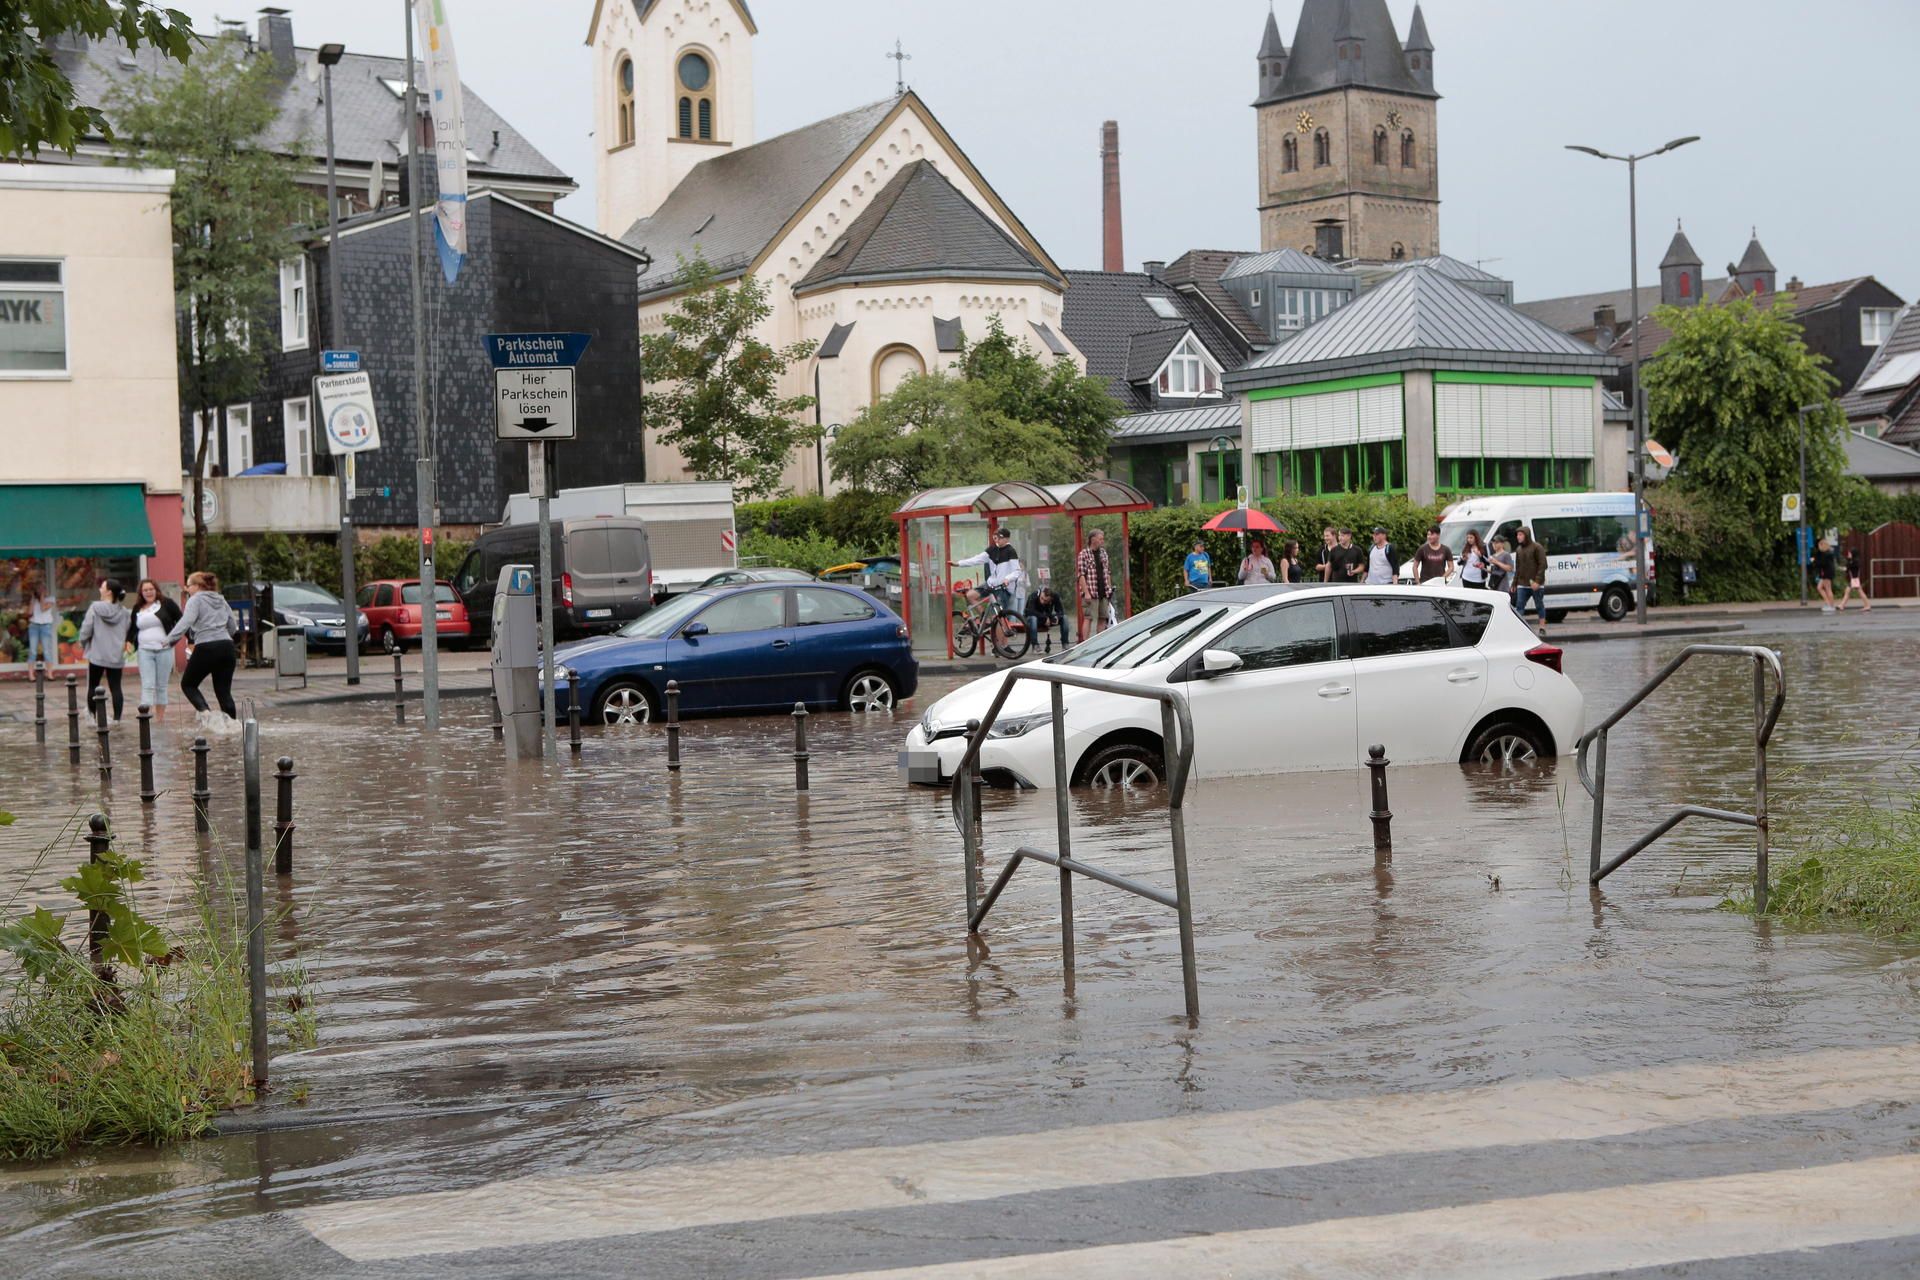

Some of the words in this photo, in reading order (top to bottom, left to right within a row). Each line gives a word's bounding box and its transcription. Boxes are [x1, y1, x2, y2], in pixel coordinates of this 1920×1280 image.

[497, 337, 564, 351] Parkschein
[508, 351, 559, 364] Automat
[522, 373, 547, 385] Hier
[501, 387, 568, 400] Parkschein
[519, 402, 551, 414] lösen
[1558, 561, 1579, 569] BEW
